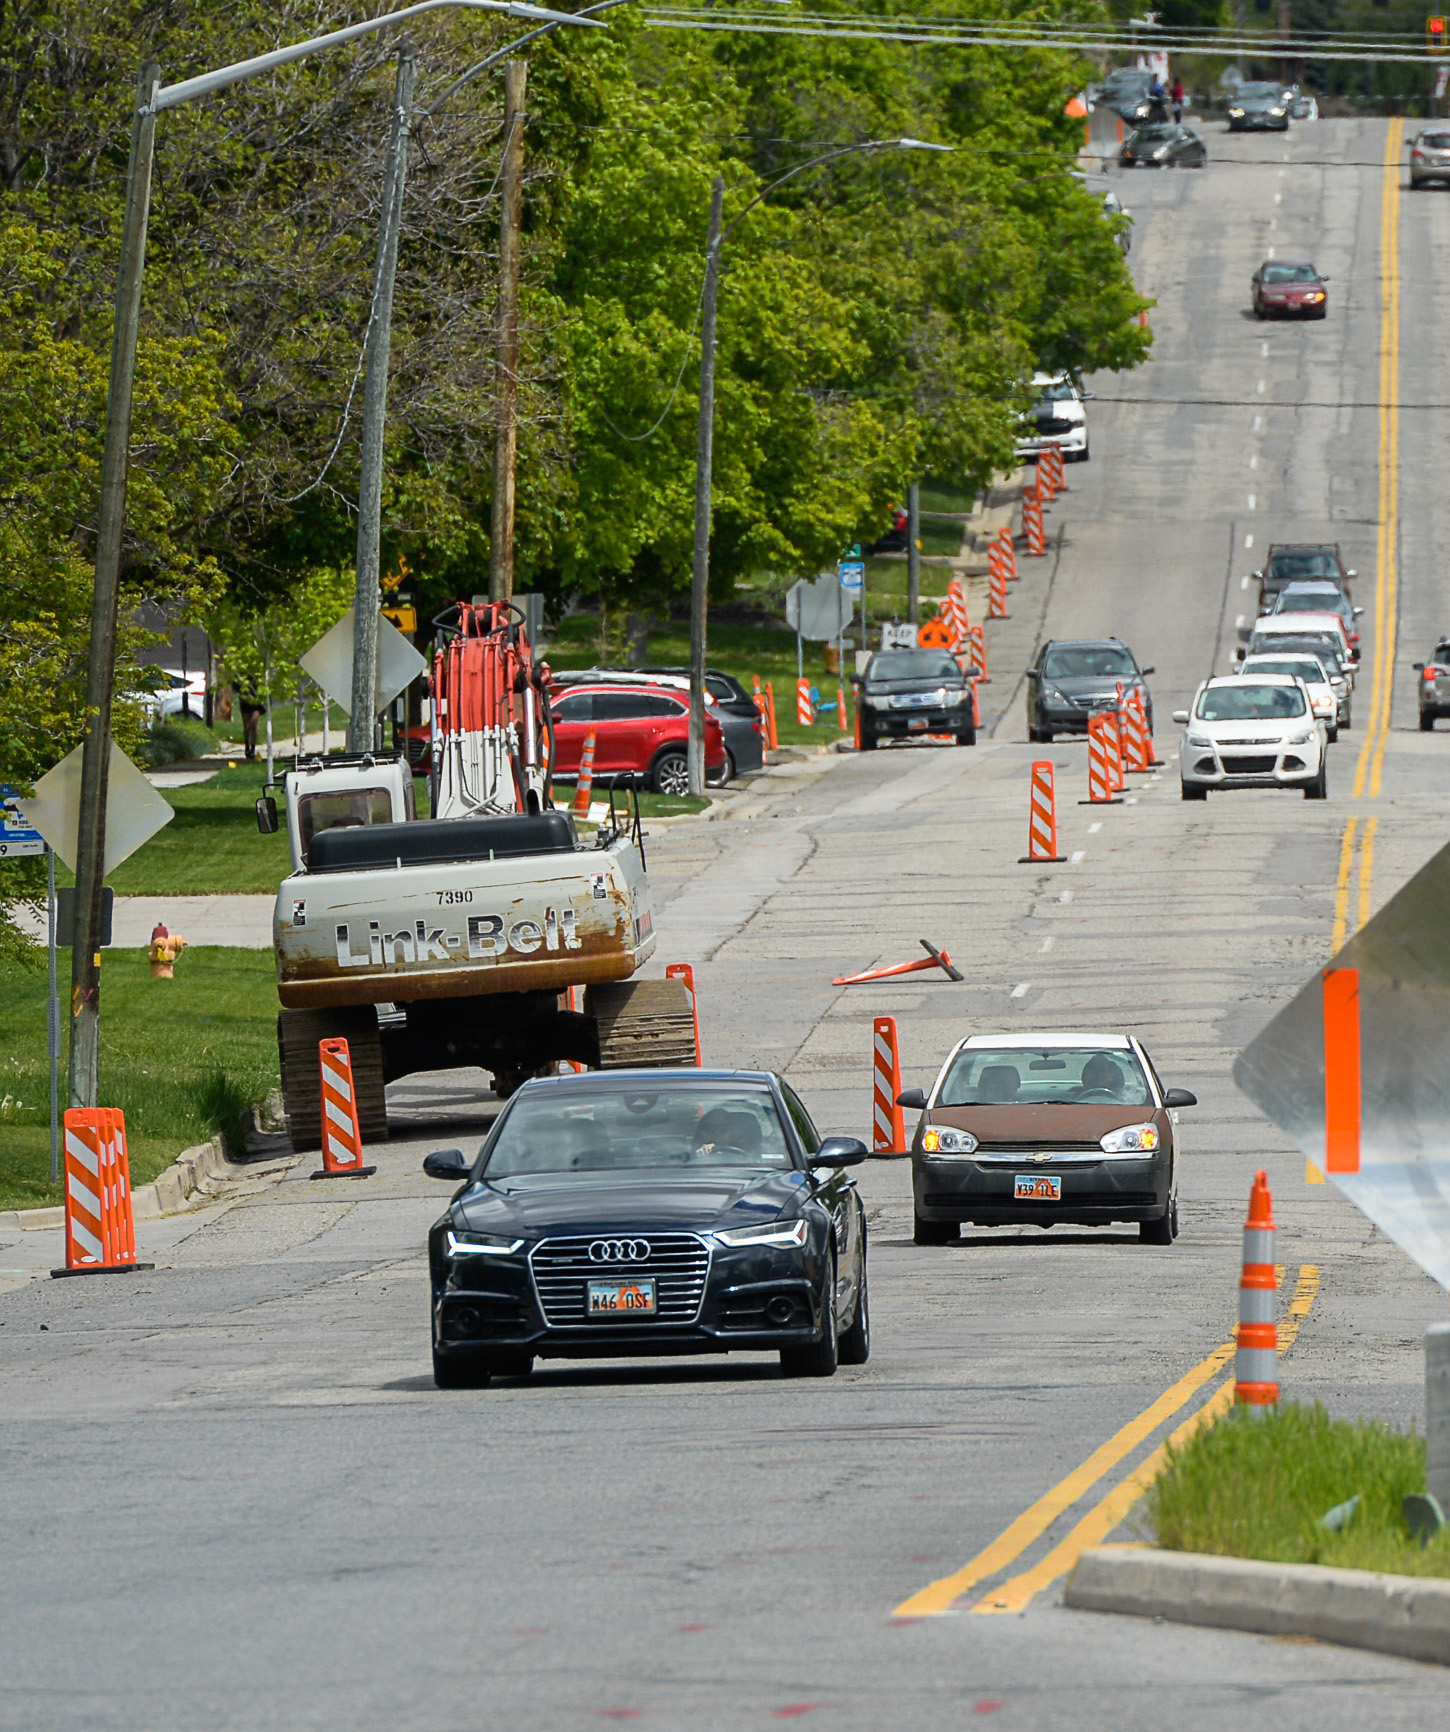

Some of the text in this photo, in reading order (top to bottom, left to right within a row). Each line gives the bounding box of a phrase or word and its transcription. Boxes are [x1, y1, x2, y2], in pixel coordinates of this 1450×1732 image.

[436, 890, 473, 906] 7390
[335, 906, 583, 967] Link-Belt
[1017, 1184, 1034, 1196] Y39
